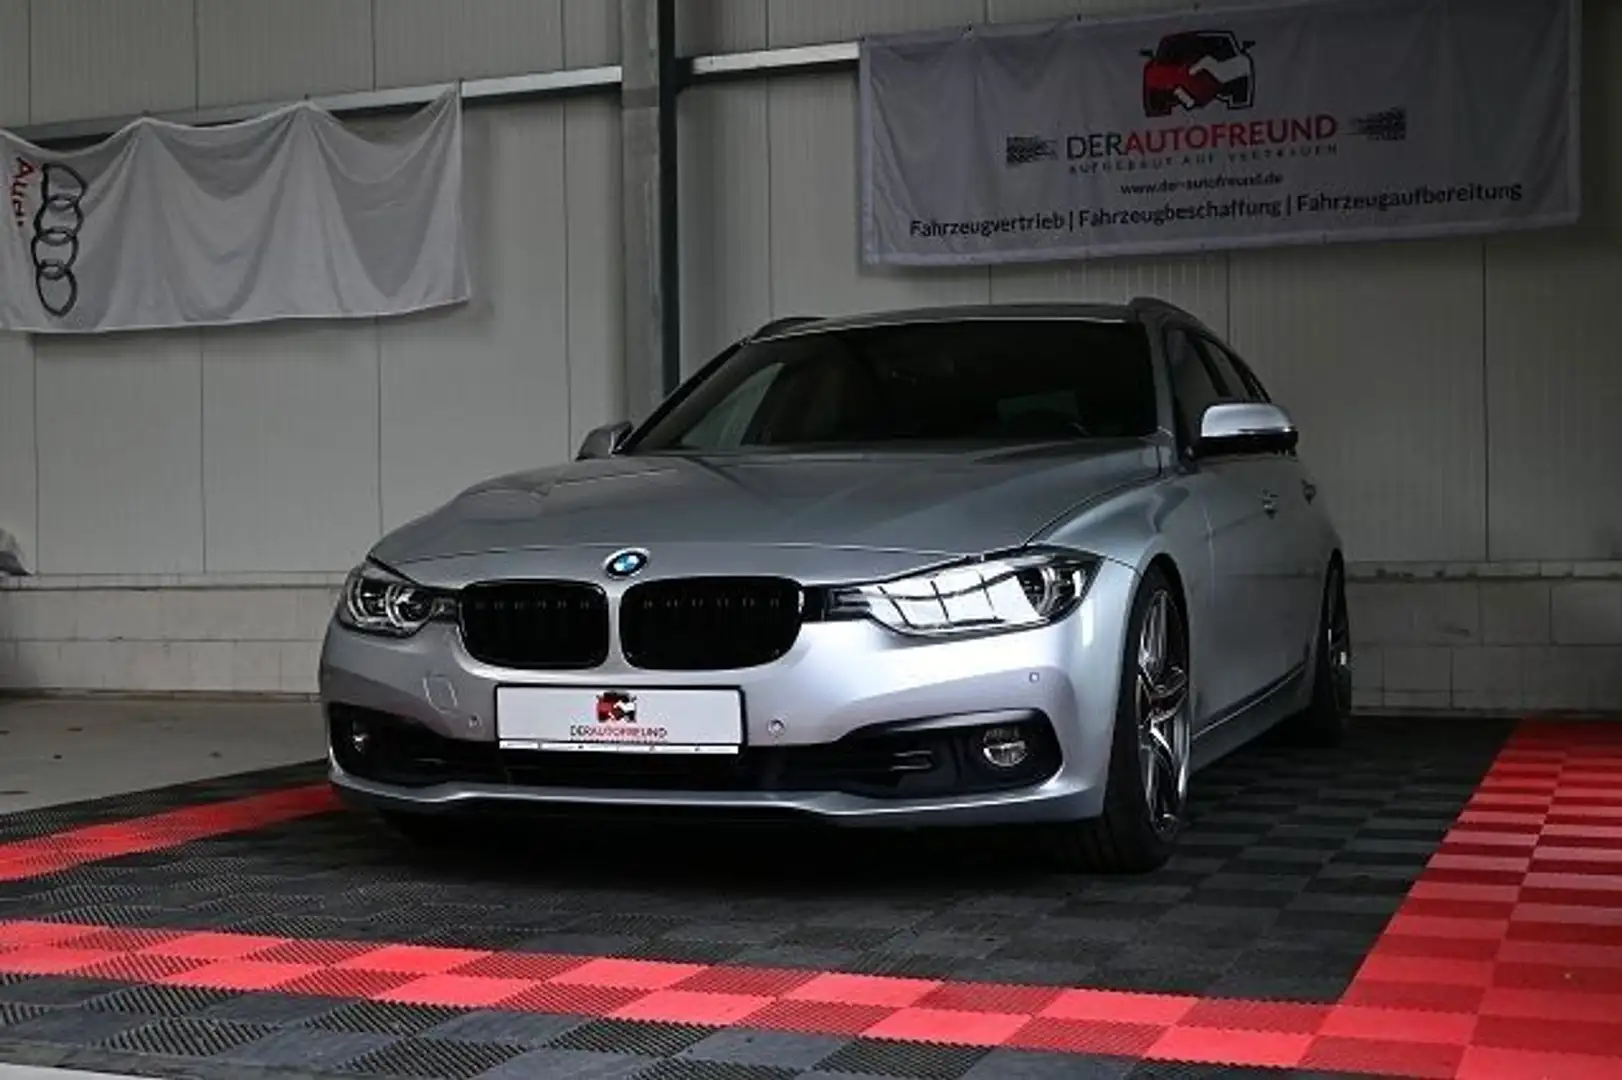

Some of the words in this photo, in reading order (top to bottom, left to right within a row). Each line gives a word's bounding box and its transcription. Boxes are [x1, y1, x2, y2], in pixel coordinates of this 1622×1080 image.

[1066, 114, 1338, 160] DERAUTOFREUND
[909, 212, 1065, 238] Fahrzeugvertrieb
[1079, 197, 1282, 227] Fahrzeugbeschaffung
[1297, 182, 1523, 213] Fahrzeugaufbereitung
